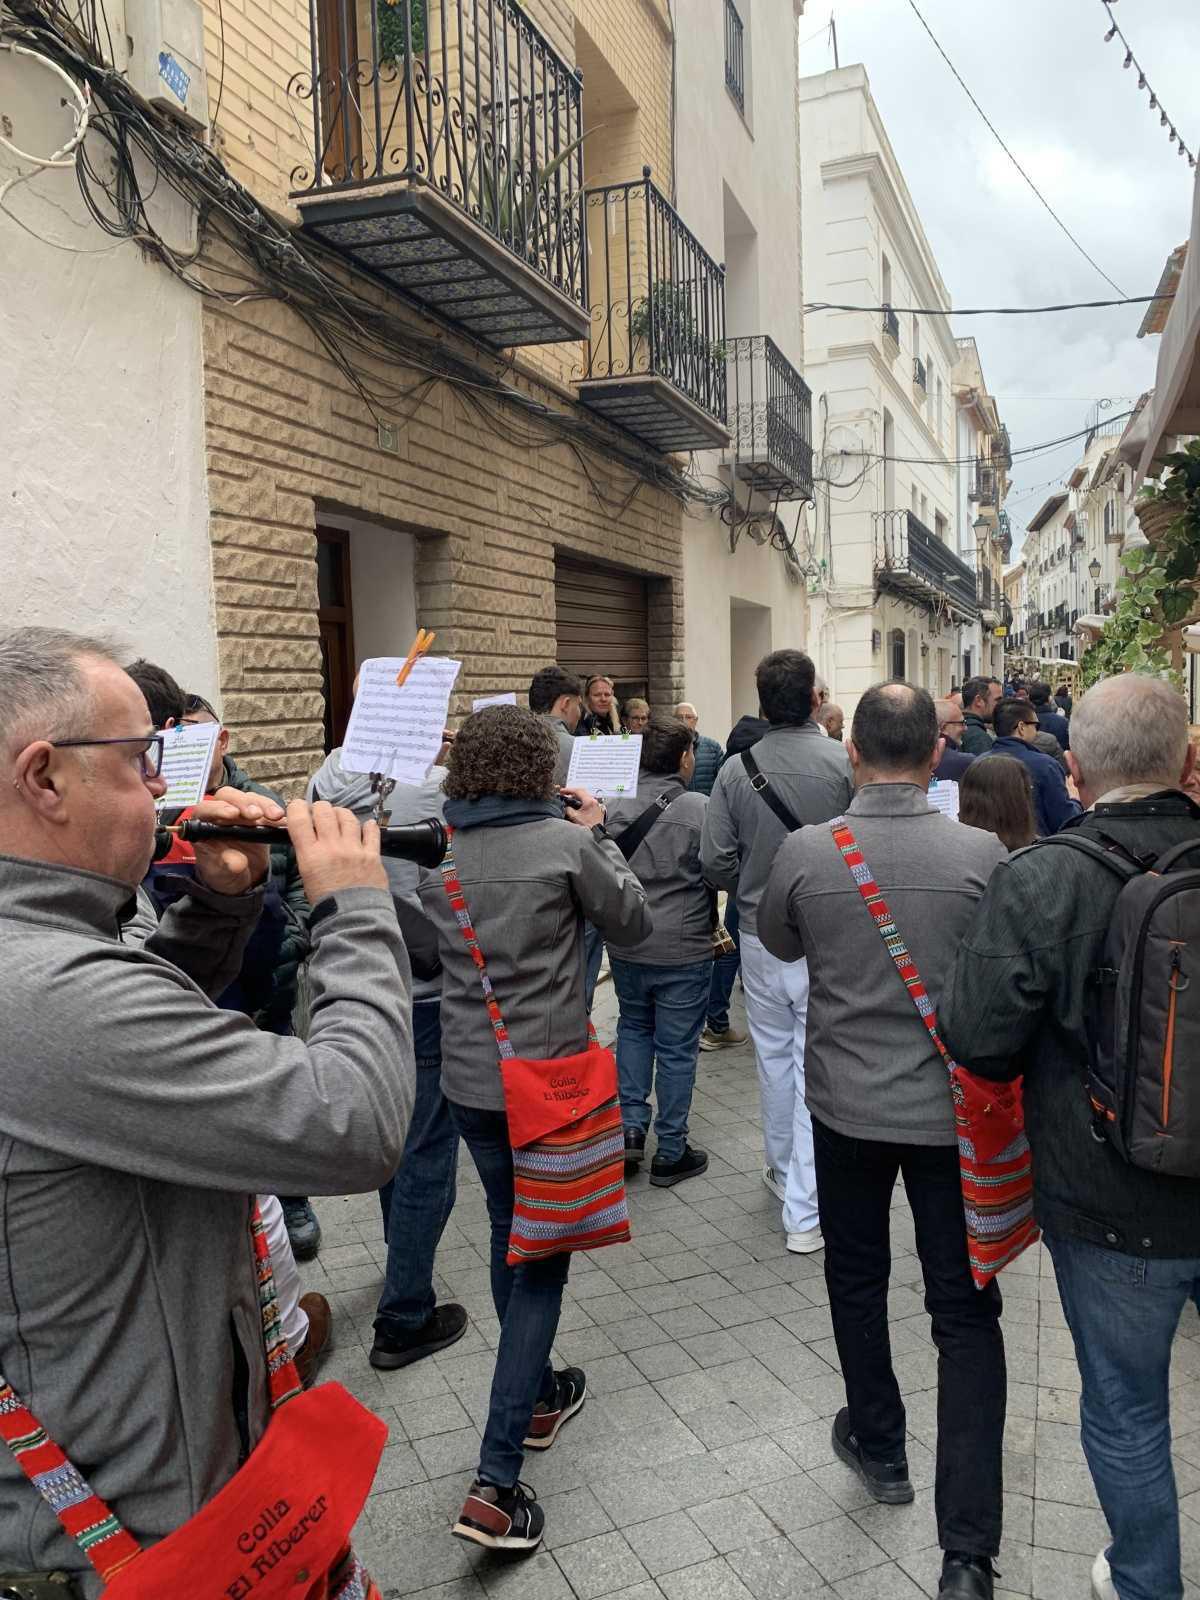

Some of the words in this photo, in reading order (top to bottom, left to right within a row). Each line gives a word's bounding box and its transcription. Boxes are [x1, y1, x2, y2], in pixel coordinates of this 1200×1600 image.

[225, 1576, 253, 1600] El
[251, 1496, 327, 1579] Riberer
[237, 1500, 290, 1554] Colla
